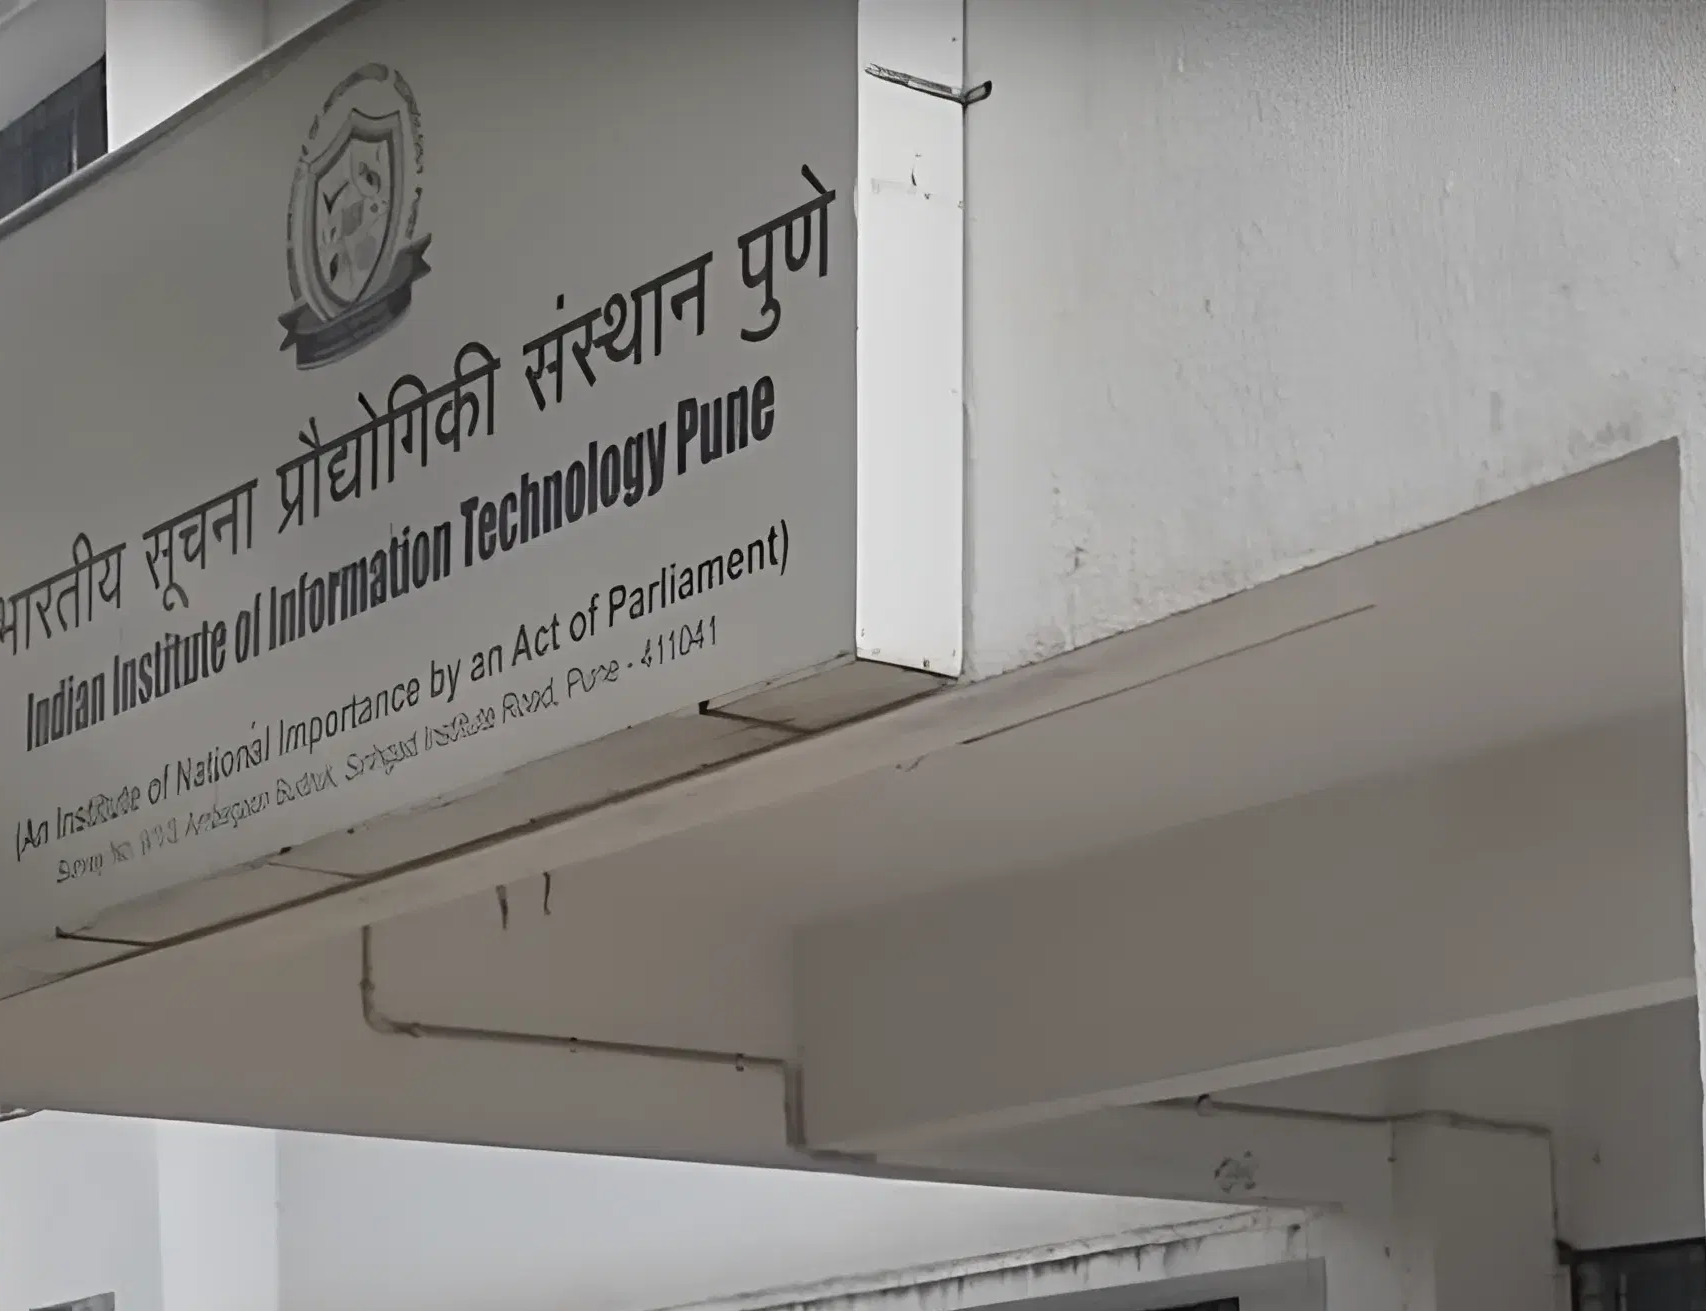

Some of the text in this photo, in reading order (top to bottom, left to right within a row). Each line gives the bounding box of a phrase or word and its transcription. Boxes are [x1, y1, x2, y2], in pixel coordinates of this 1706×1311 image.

[26, 375, 775, 752] Indian Institute of Information Technology Pune
[142, 478, 258, 611] सूचना
[276, 341, 501, 534] प्रौद्योगिकी
[523, 293, 713, 412] संस्थान
[737, 164, 836, 342] पुणे
[16, 817, 49, 862] (An
[148, 763, 170, 805] of
[177, 724, 270, 796] National
[278, 678, 420, 756] Importance
[431, 657, 461, 703] by
[471, 644, 502, 681] an
[511, 613, 561, 666] Act
[569, 592, 601, 643] of
[608, 519, 789, 628] Parliament)
[640, 615, 717, 668] 411041
